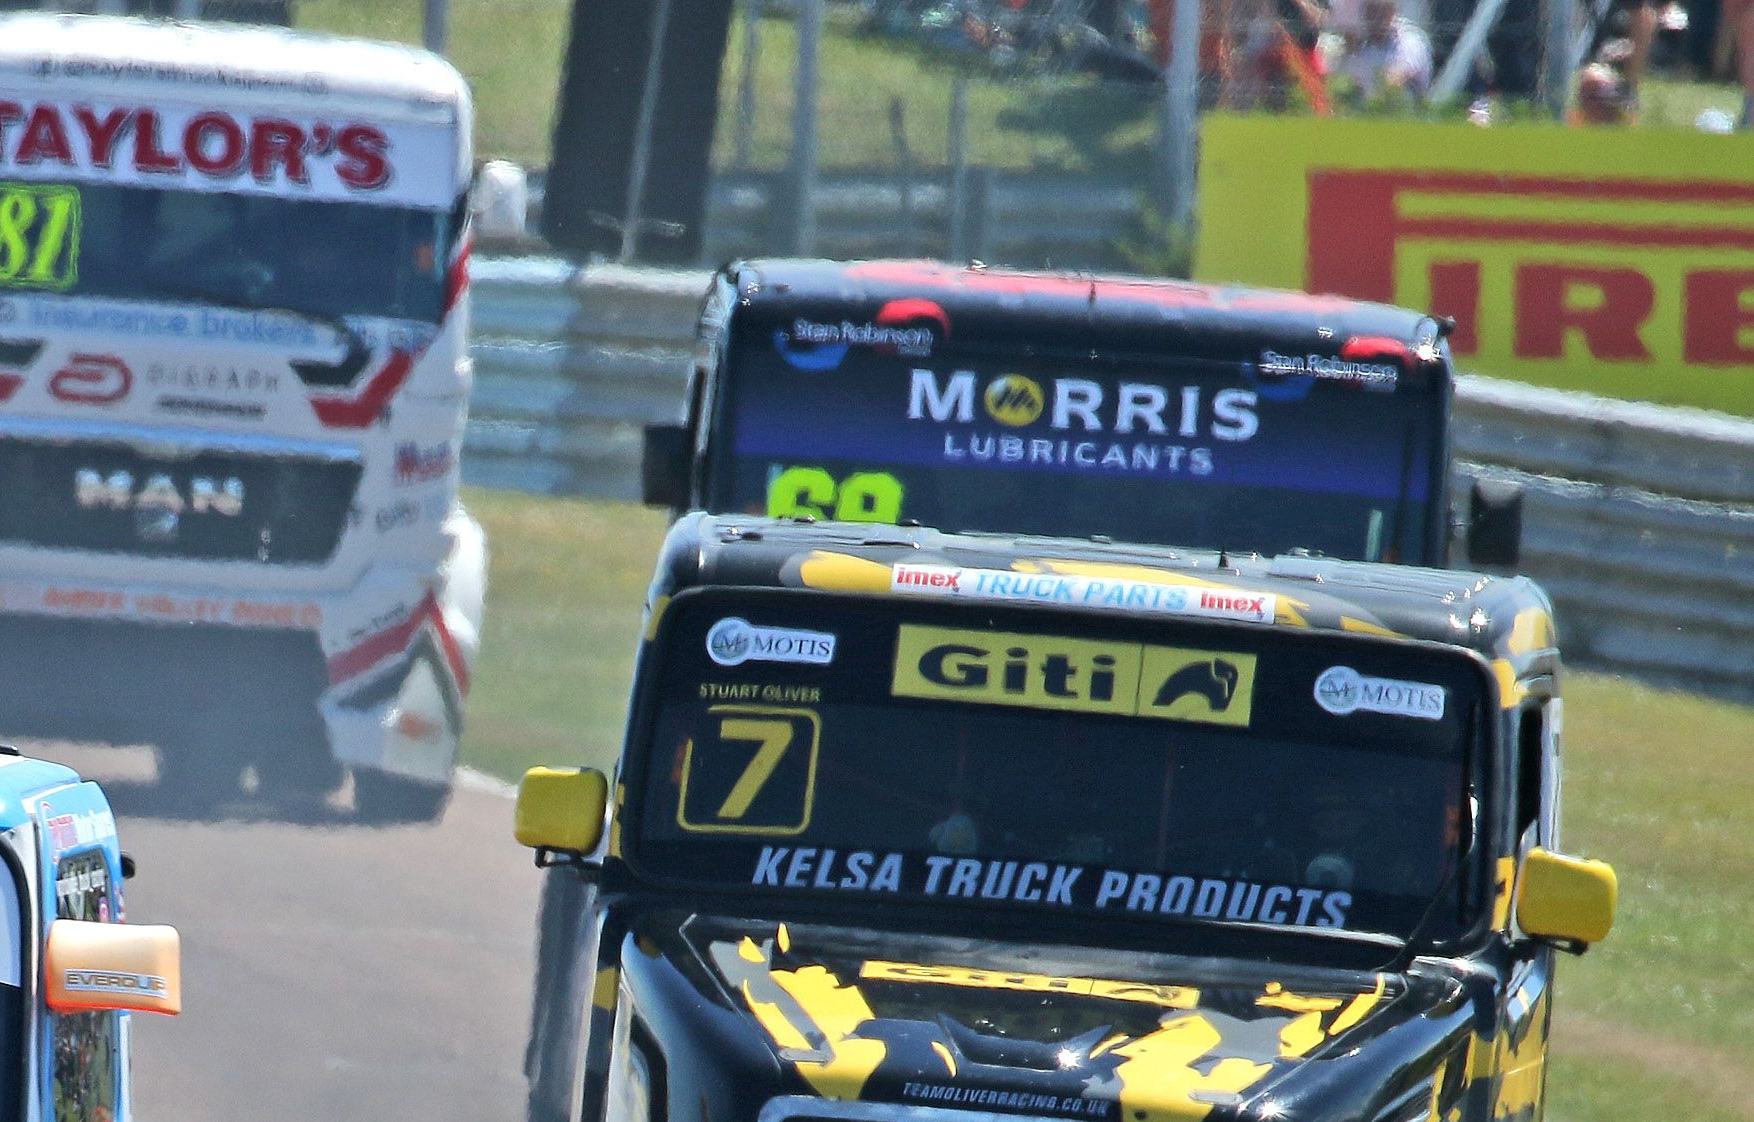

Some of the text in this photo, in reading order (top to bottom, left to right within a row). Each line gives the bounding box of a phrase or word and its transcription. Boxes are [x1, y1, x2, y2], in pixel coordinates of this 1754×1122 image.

[907, 369, 1260, 441] MORRIS
[944, 433, 1214, 476] LUBRICANTS
[75, 468, 244, 516] MAN
[897, 568, 1266, 614] imex TRUCK PARTS imex
[750, 634, 831, 657] MOTIS
[699, 683, 821, 702] STUART OLIVER
[918, 643, 1116, 702] Giti
[1362, 682, 1441, 711] MOTIS
[717, 719, 794, 818] 7
[752, 847, 1352, 929] KELSA TRUCK PRODUCTS
[903, 1082, 1111, 1116] TEAMOLIVERRACING.CO.UK
